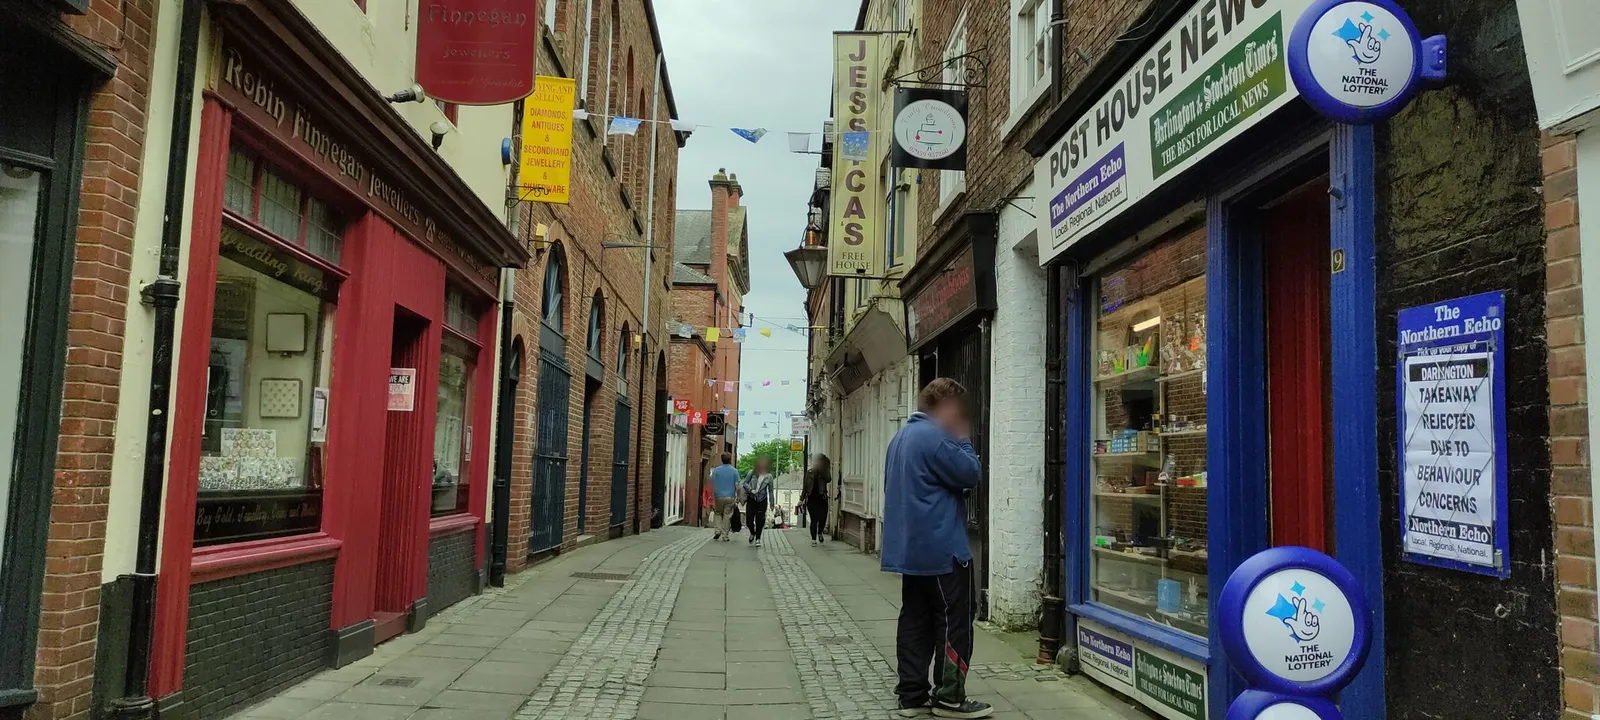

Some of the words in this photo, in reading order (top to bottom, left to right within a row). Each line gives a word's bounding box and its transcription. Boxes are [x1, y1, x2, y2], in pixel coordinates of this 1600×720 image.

[428, 4, 527, 27] Finnegan
[1359, 68, 1377, 76] THE
[1154, 101, 1196, 148] Darlington
[1196, 94, 1203, 116] &
[1203, 61, 1246, 112] Stockton
[1245, 29, 1277, 78] Times
[1342, 75, 1388, 87] NATIONAL
[1343, 84, 1386, 95] LOTTERY
[535, 93, 565, 103] SELLING
[559, 85, 573, 95] AND
[1050, 118, 1091, 188] POST
[1096, 40, 1173, 149] HOUSE
[1180, 0, 1267, 74] NEW
[225, 50, 285, 129] Robin
[292, 103, 364, 188] Finnegan
[530, 108, 567, 120] DIAMONDS,
[1161, 149, 1176, 167] THE
[1177, 135, 1196, 157] BEST
[1196, 124, 1212, 144] FOR
[1212, 100, 1241, 131] LOCAL
[1241, 78, 1269, 112] NEWS
[532, 121, 565, 132] ANTIQUES
[524, 145, 569, 157] SECONDHAND
[841, 40, 867, 245] JESSCA'S
[526, 159, 565, 169] JEWELLERY
[543, 172, 548, 180] &
[1052, 203, 1064, 219] The
[1065, 175, 1099, 210] Northern
[1100, 157, 1122, 183] Echo
[1055, 221, 1069, 239] Local.
[1070, 203, 1095, 227] Regional.
[1095, 183, 1123, 210] National.
[221, 228, 289, 276] Wedding
[842, 252, 865, 260] FREE
[1334, 251, 1342, 270] 9
[836, 260, 871, 271] HOUSE
[1434, 305, 1460, 322] The
[1401, 324, 1459, 345] Northern
[1463, 316, 1501, 335] Echo
[1469, 340, 1477, 350] of
[398, 376, 409, 384] ARE
[1419, 385, 1478, 403] TAKEAWAY
[1422, 413, 1476, 430] REJECTED
[1431, 440, 1452, 456] DUE
[1454, 440, 1470, 457] TO
[1417, 465, 1482, 485] BEHAVIOUR
[1419, 491, 1477, 514] CONCERNS
[196, 507, 212, 532] Buy
[215, 506, 235, 523] Gold,
[1411, 517, 1456, 538] Northern
[1459, 524, 1489, 543] Echo
[1457, 545, 1489, 558] National.
[1080, 631, 1089, 644] The
[1090, 635, 1115, 655] Northern
[1115, 645, 1131, 661] Echo
[1300, 644, 1319, 653] THE
[1285, 650, 1333, 663] NATIONAL
[1288, 660, 1331, 671] LOTTERY
[1166, 691, 1182, 708] LOCAL
[1182, 698, 1197, 715] NEWS
